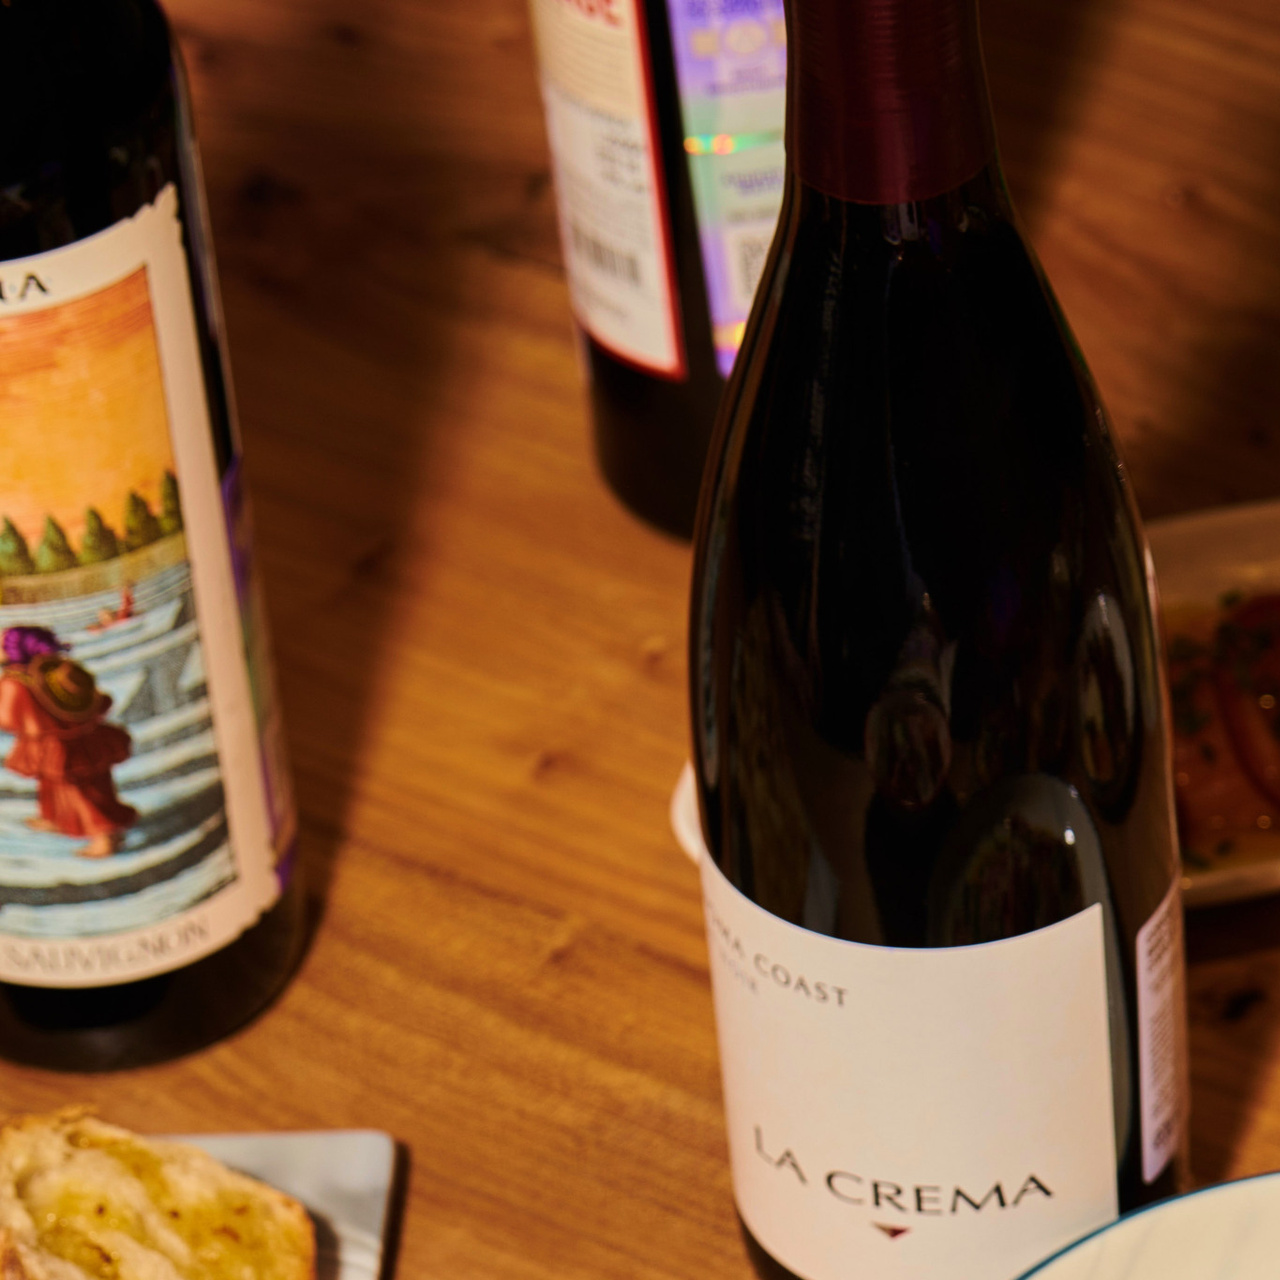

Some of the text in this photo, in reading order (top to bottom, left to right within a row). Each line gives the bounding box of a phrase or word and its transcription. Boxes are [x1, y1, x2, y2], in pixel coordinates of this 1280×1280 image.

[753, 953, 848, 1006] COAST
[754, 1125, 1053, 1214] LA CREMA
